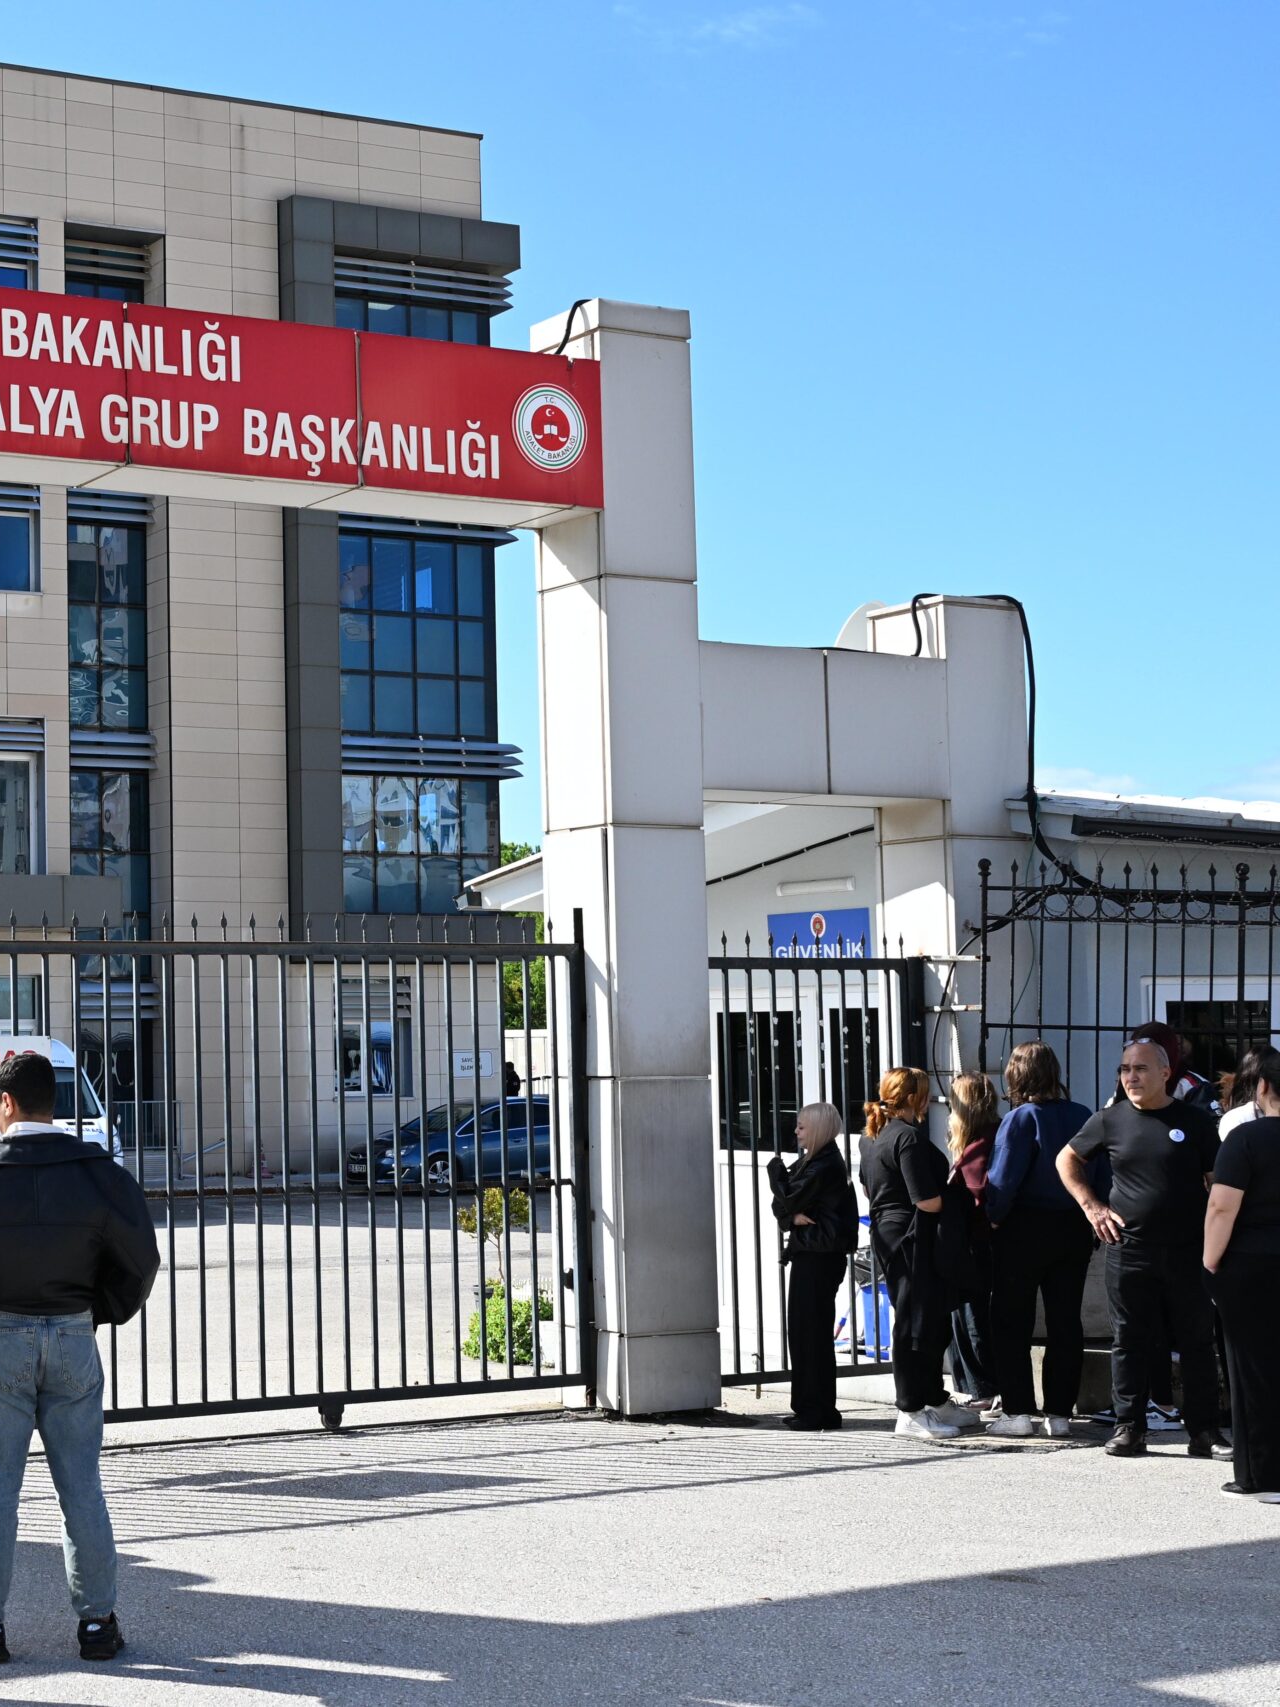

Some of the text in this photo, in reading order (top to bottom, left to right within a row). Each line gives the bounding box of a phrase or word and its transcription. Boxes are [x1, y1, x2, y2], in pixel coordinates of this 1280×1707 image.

[1, 308, 241, 383] BAKANLIĞI
[100, 393, 219, 451] GRUP
[243, 408, 500, 480] BAŞKANLIĞI
[525, 430, 545, 456] ADALET
